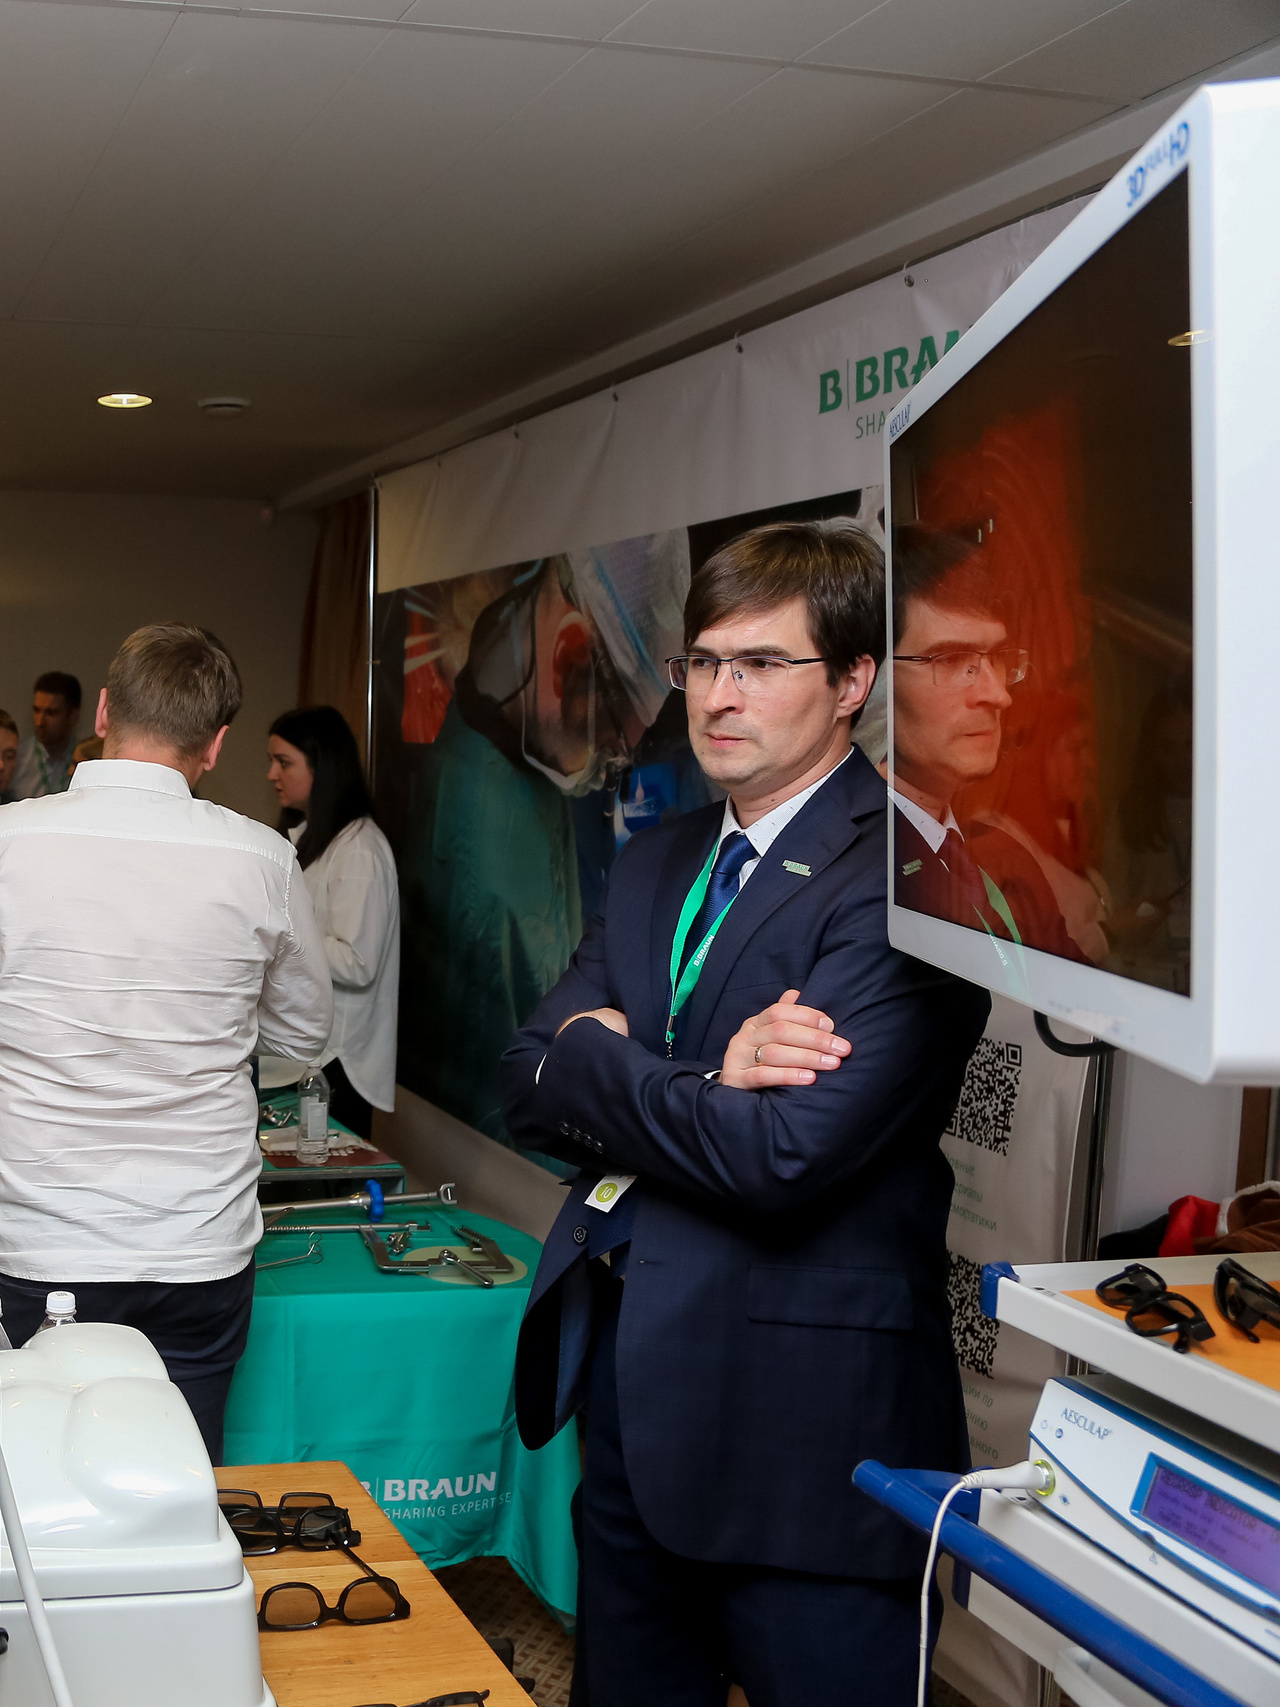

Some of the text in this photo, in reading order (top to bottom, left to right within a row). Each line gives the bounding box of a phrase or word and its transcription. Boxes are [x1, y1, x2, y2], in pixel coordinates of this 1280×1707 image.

[819, 326, 967, 414] B BRA
[855, 408, 890, 439] SHA
[696, 934, 715, 960] BRAUN
[600, 1186, 614, 1199] 10
[951, 1203, 997, 1231] мостатики
[1060, 1407, 1110, 1440] AESCULAP
[969, 1437, 999, 1460] вного
[383, 1472, 497, 1502] BRAUN
[383, 1491, 512, 1520] SHARING EXPERTSE
